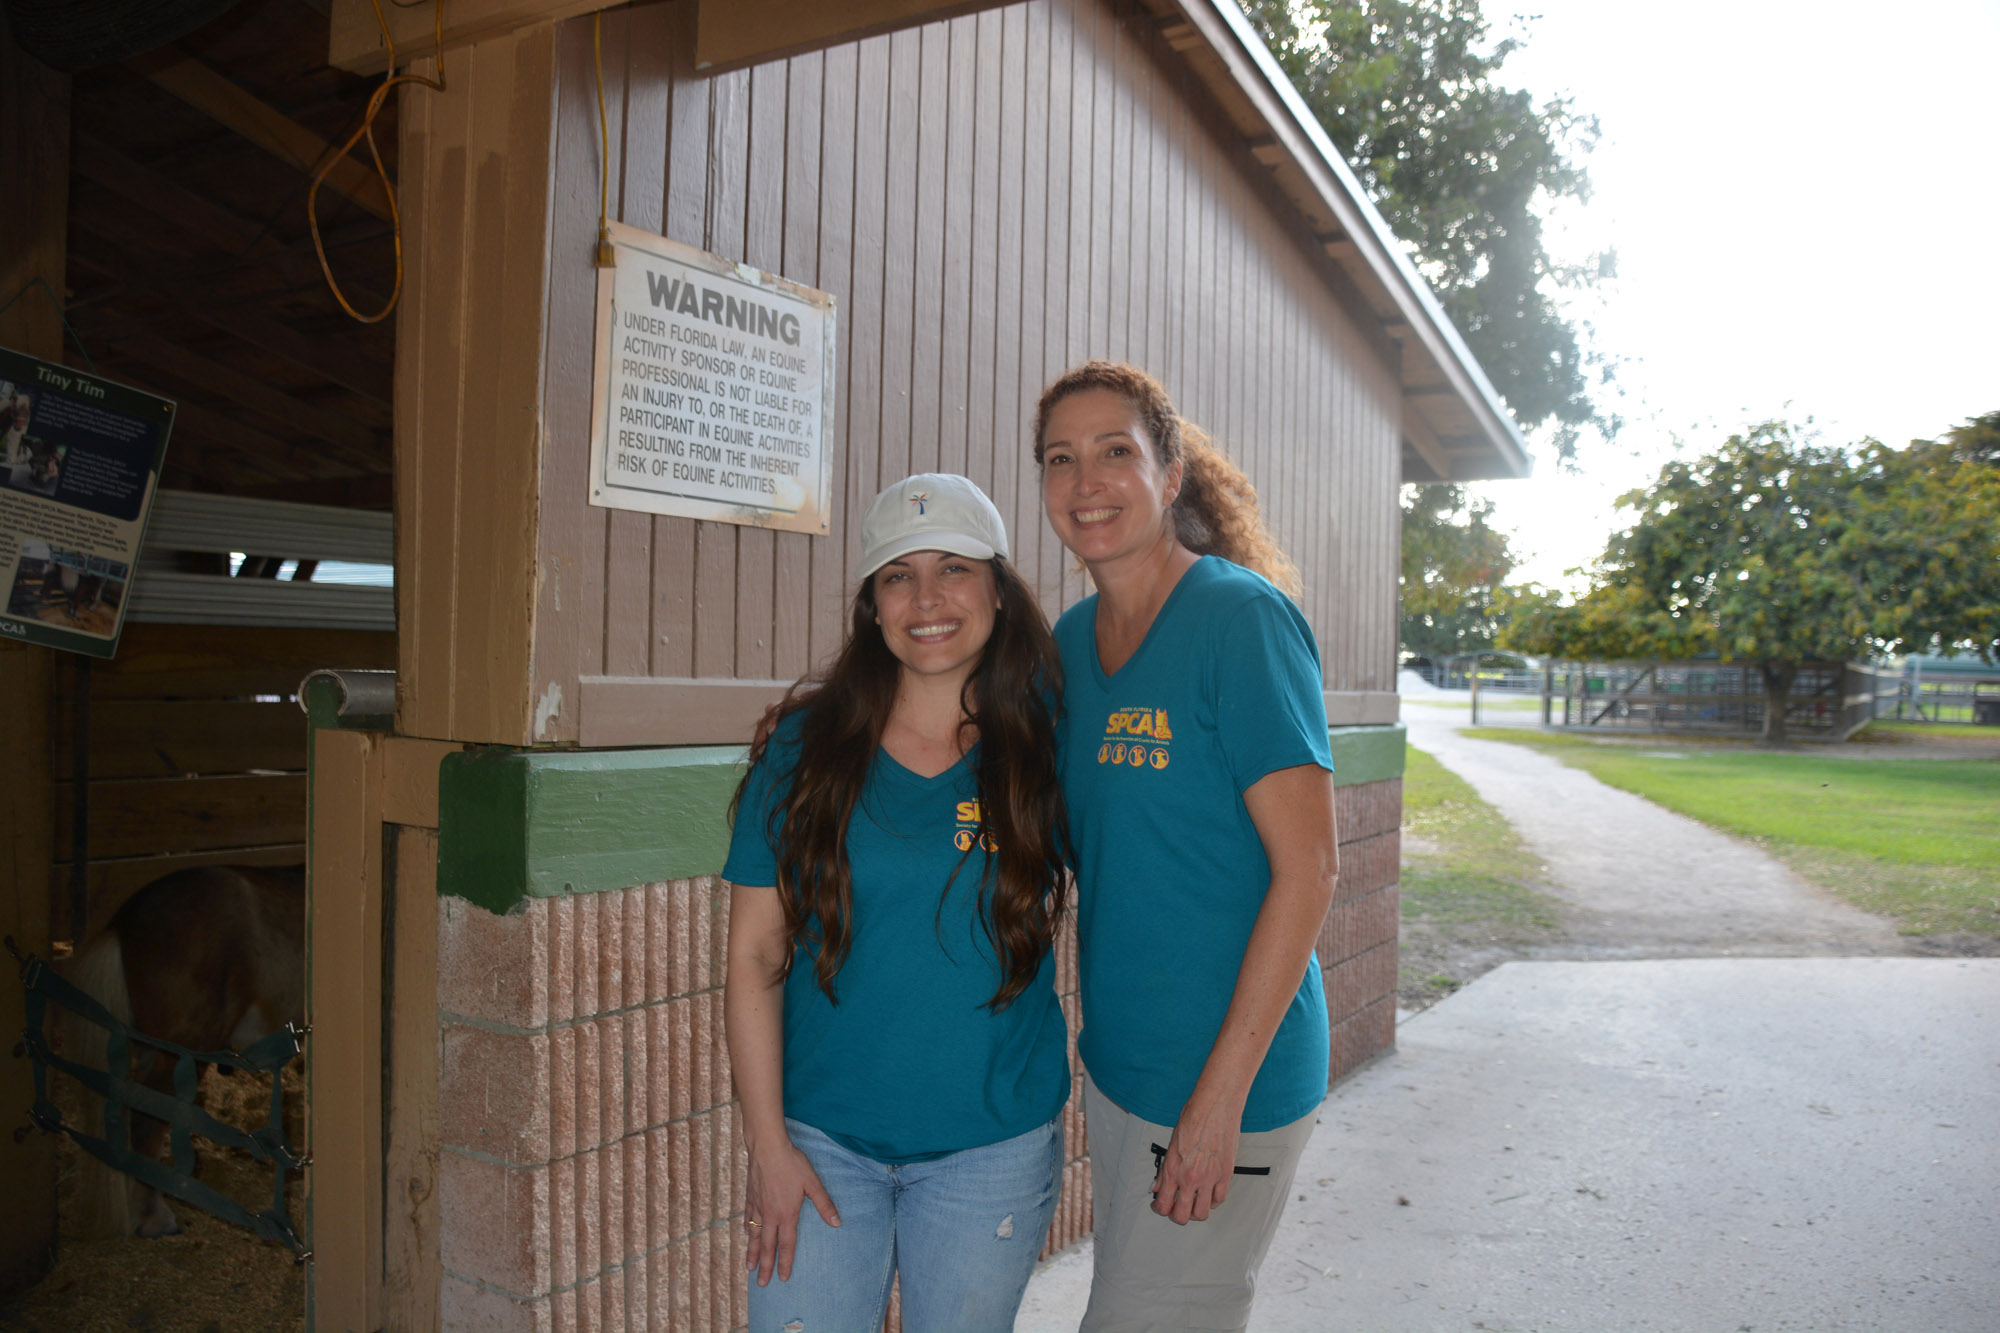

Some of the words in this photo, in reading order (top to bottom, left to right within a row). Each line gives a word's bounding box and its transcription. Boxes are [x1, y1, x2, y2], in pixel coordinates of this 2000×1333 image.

[646, 269, 801, 347] WARNING
[624, 311, 666, 338] UNDER
[670, 323, 718, 351] FLORIDA
[751, 346, 766, 364] AN
[769, 351, 807, 375] EQUINE
[624, 335, 676, 363] ACTIVITY
[681, 350, 736, 378] SPONSOR
[740, 364, 756, 382] OR
[760, 370, 797, 393] EQUINE
[36, 366, 73, 391] Tiny
[76, 378, 106, 400] Tim
[621, 382, 639, 402] AN
[643, 386, 684, 411] INJURY
[709, 401, 726, 420] OR
[729, 405, 749, 425] THE
[753, 411, 786, 432] DEATH
[806, 424, 813, 438] A
[622, 358, 711, 395] PROFESSIONAL
[715, 380, 726, 398] IS
[730, 384, 751, 404] NOT
[755, 389, 789, 413] LIABLE
[792, 399, 812, 417] FOR
[619, 430, 685, 457] RESULTING
[689, 442, 721, 463] FROM
[725, 449, 746, 468] THE
[750, 454, 800, 477] INHERENT
[620, 406, 695, 436] PARTICIPANT
[699, 421, 710, 438] IN
[714, 424, 754, 447] EQUINE
[758, 434, 811, 459] ACTIVITIES
[617, 454, 647, 475] RISK
[651, 459, 669, 477] OF
[673, 462, 716, 485] EQUINE
[719, 470, 778, 495] ACTIVITIES.
[1106, 712, 1153, 736] SPCA
